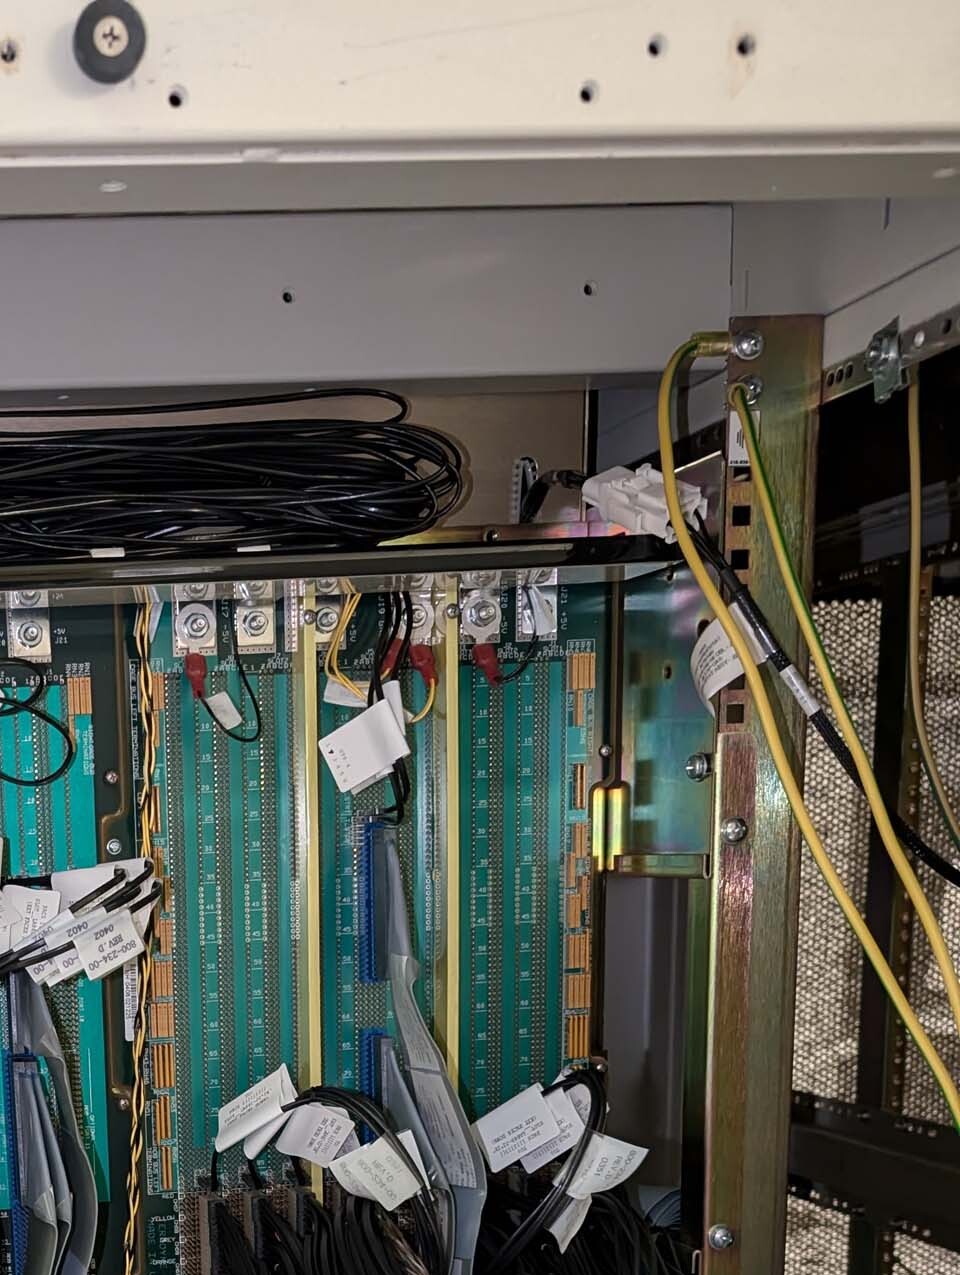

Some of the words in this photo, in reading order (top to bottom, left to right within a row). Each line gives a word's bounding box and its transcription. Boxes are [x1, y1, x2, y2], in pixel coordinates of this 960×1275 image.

[560, 612, 568, 631] +5V
[66, 922, 88, 937] 0402
[94, 924, 114, 940] 0402
[98, 934, 124, 952] REV.D
[88, 940, 136, 971] 800-234-00
